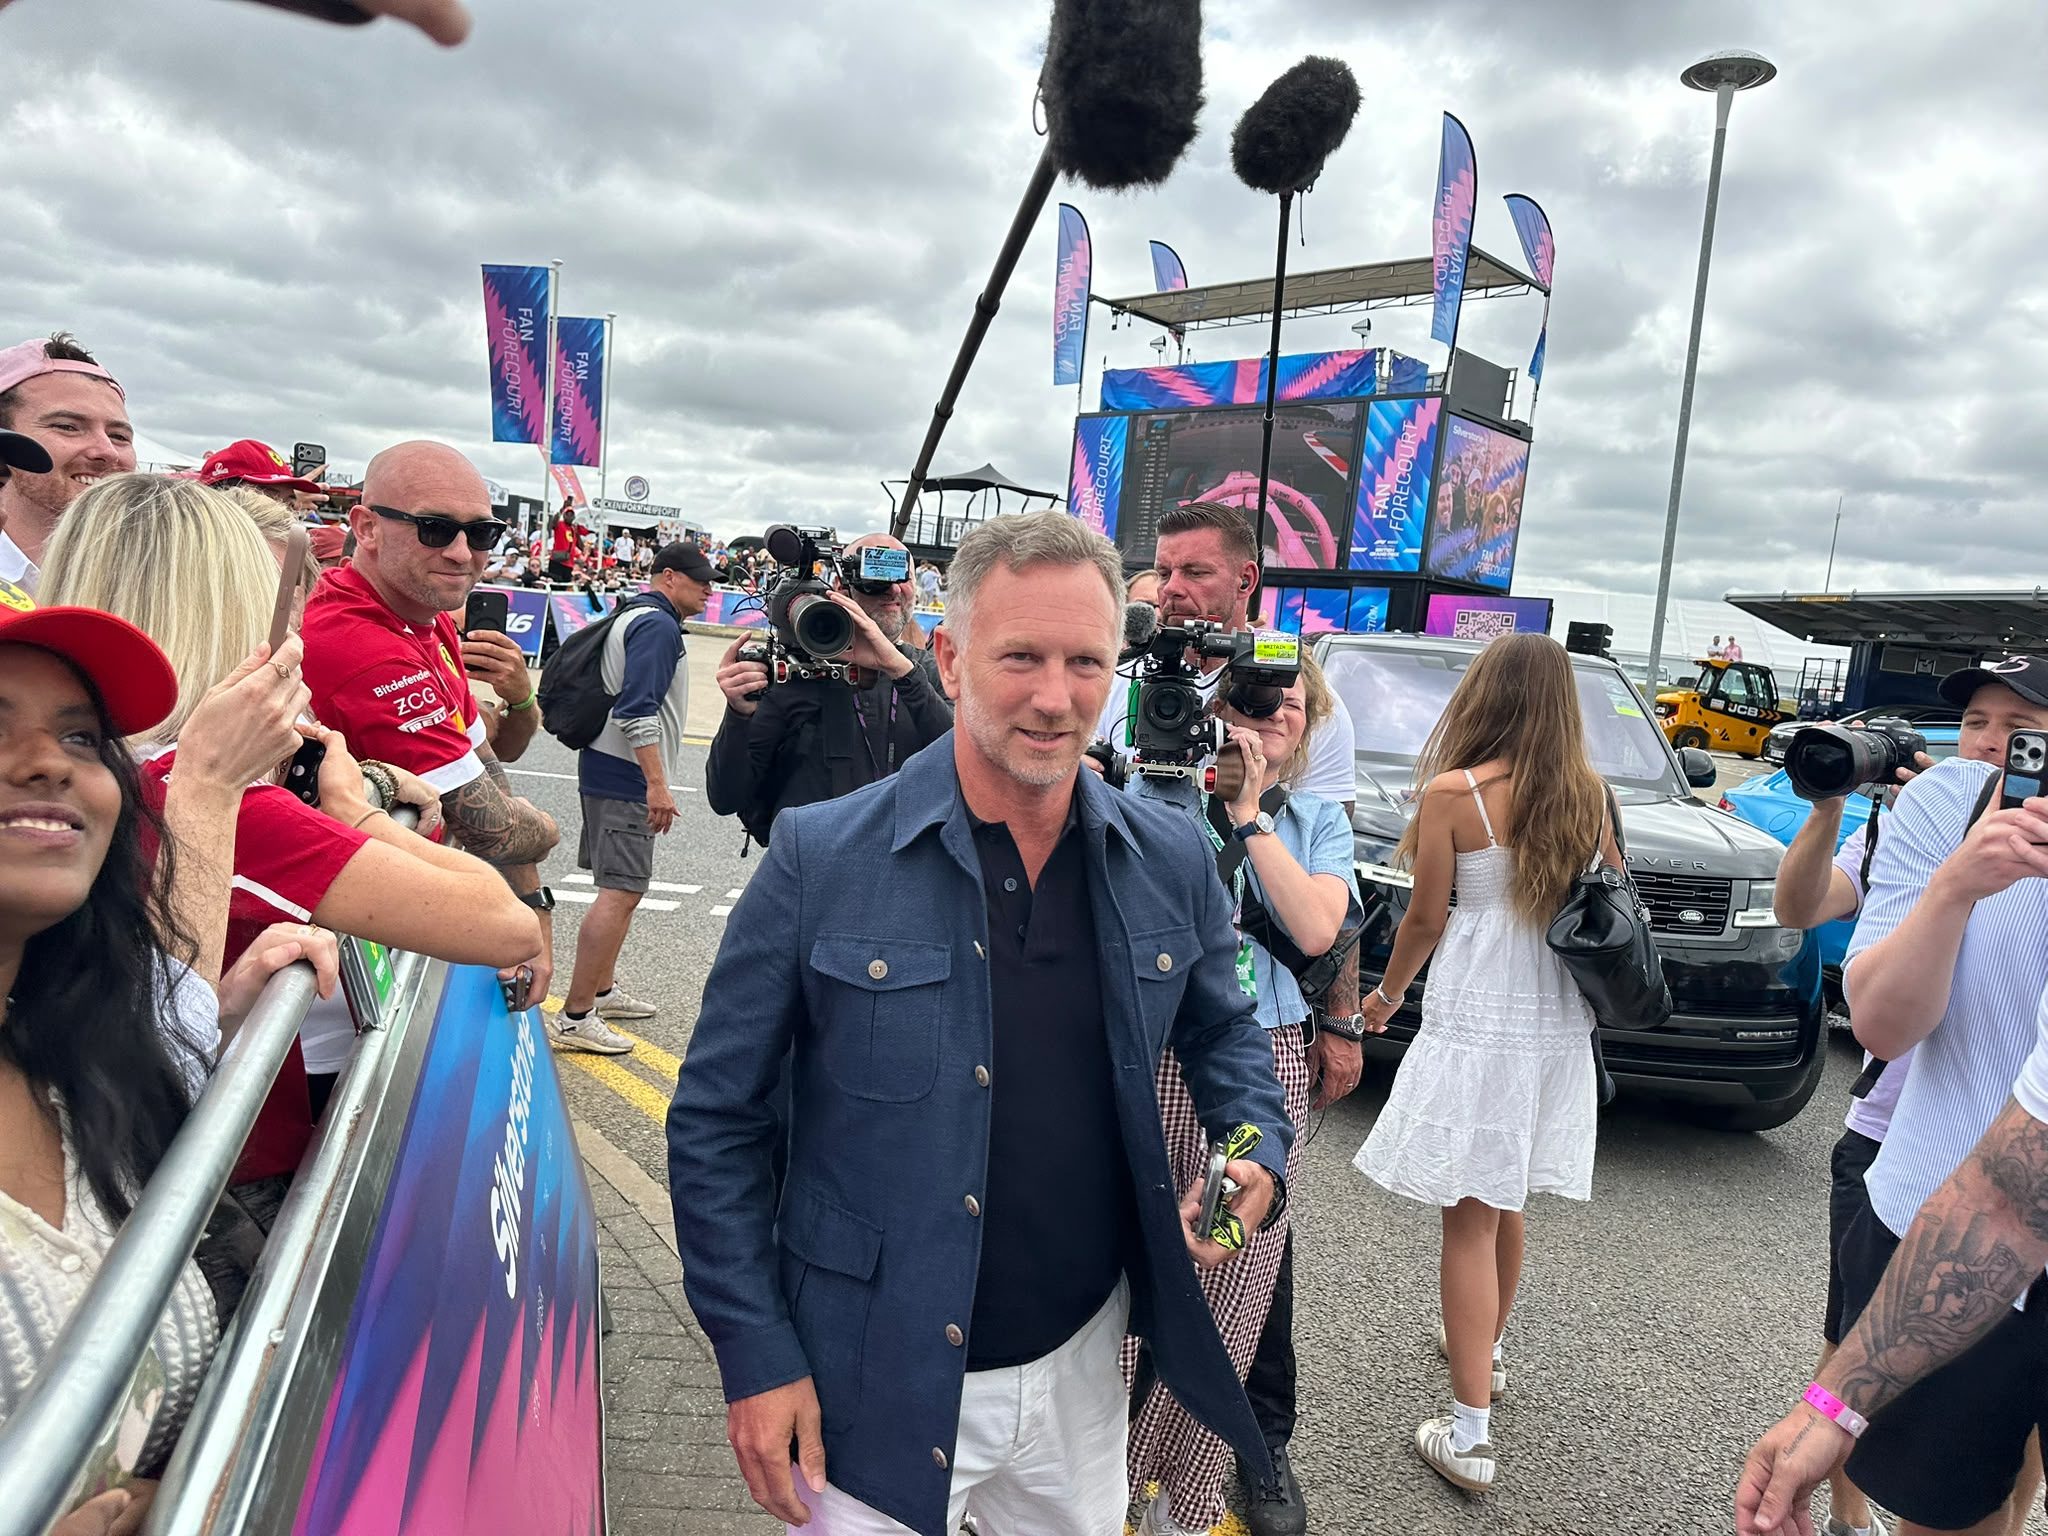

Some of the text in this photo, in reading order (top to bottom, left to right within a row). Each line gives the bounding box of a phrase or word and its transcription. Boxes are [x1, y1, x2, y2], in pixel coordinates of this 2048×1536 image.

[518, 307, 534, 341] FAN
[502, 316, 522, 419] FORECOURT
[576, 351, 589, 380] FAN
[559, 360, 575, 445] FORECOURT
[1452, 424, 1485, 444] Silverstone
[1092, 434, 1112, 528] FORECOURT
[1389, 420, 1418, 531] FORECOURT
[592, 498, 622, 511] CHCKEN
[1080, 487, 1094, 518] FAN
[1372, 483, 1391, 519] FAN
[1476, 561, 1511, 578] FORECOURT
[1480, 549, 1494, 561] FAN
[373, 670, 431, 697] Bitdefende
[1728, 703, 1759, 717] JCB
[1625, 855, 1708, 870] OVER
[1230, 1128, 1247, 1145] VIP
[490, 1011, 536, 1299] Silverstone
